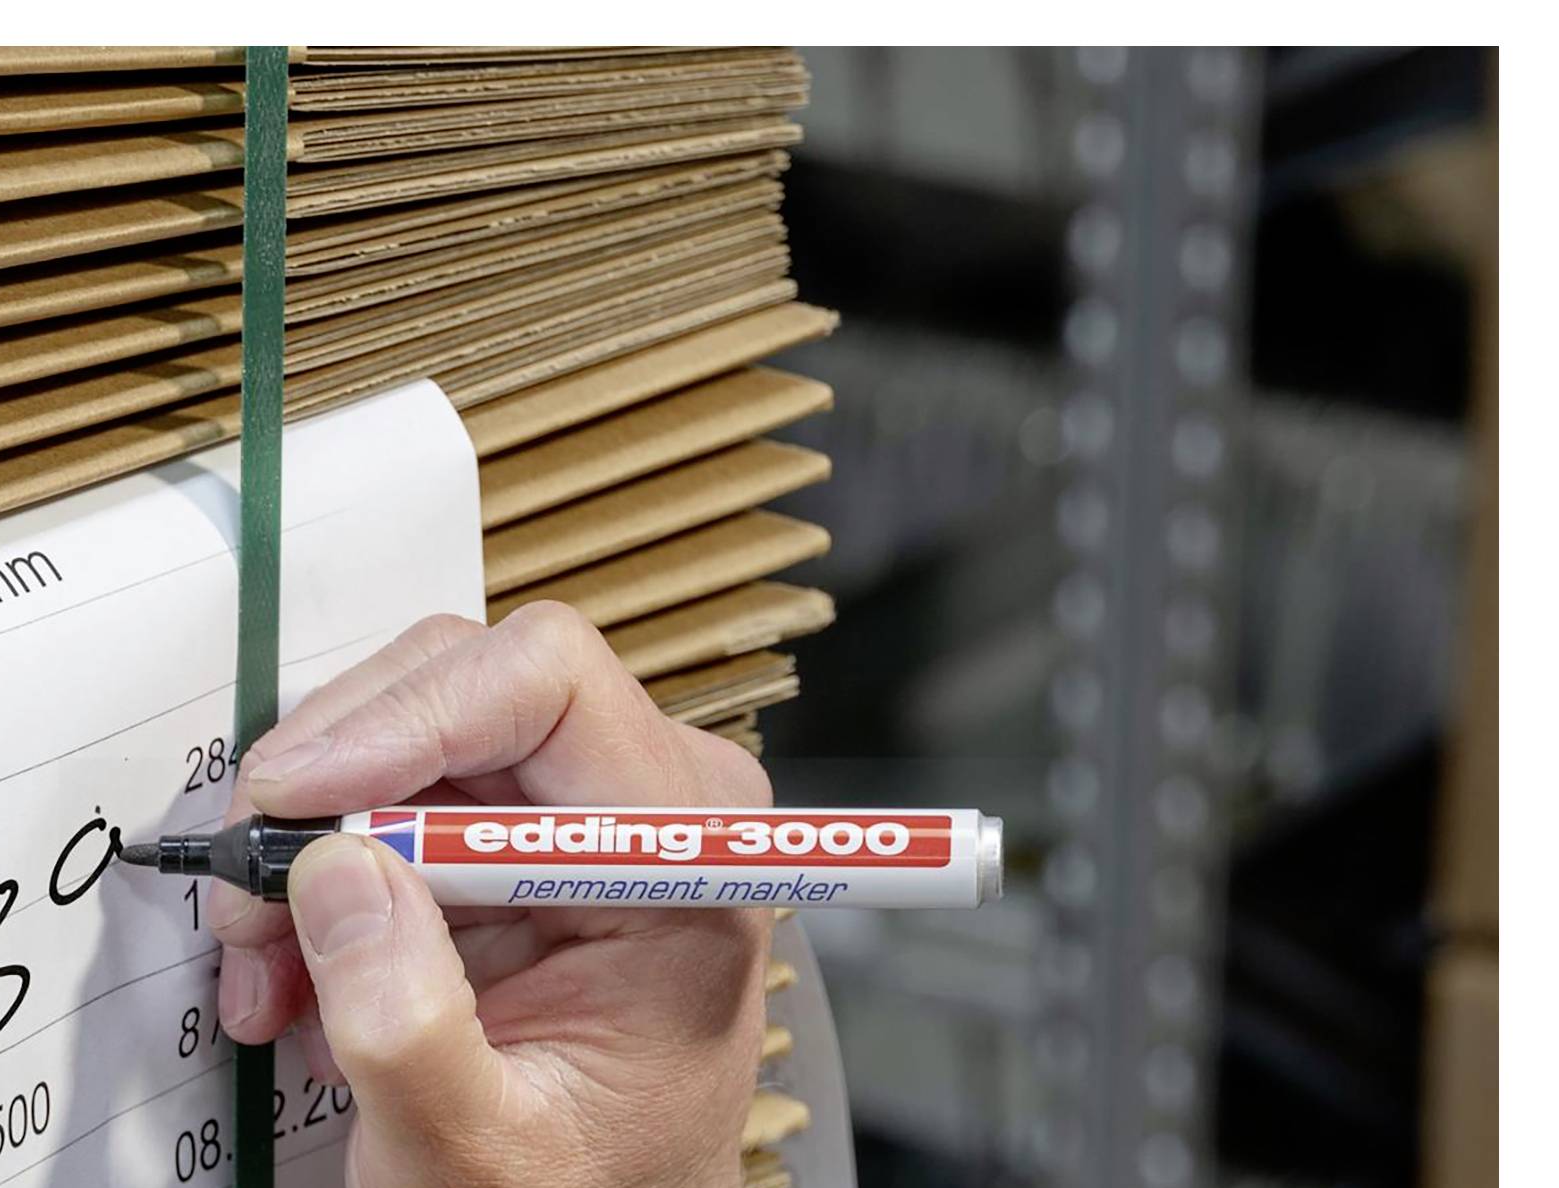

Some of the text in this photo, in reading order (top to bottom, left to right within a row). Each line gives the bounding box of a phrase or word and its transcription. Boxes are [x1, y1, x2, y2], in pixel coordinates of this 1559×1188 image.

[726, 820, 910, 856] 3000
[508, 873, 849, 904] permanent marker
